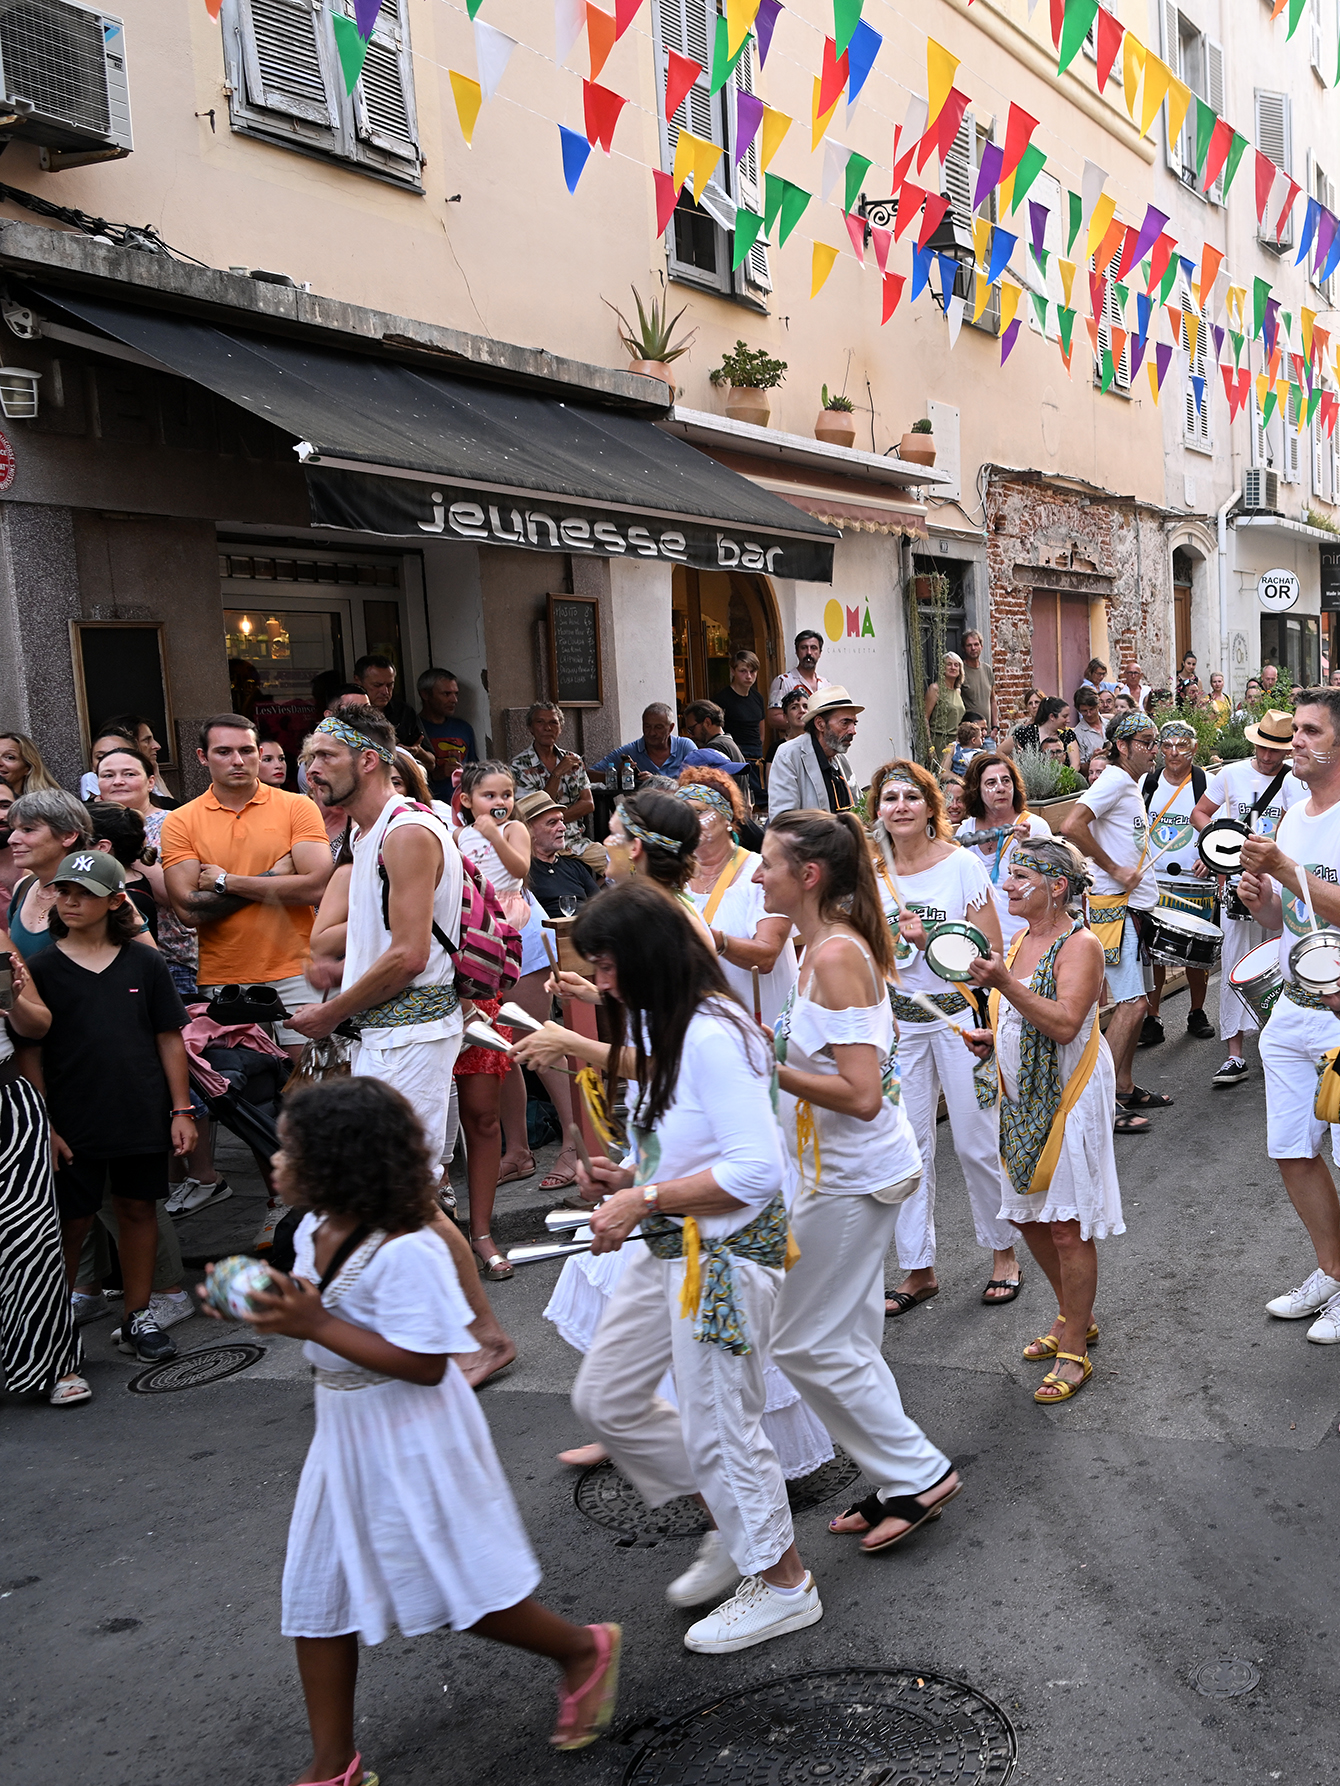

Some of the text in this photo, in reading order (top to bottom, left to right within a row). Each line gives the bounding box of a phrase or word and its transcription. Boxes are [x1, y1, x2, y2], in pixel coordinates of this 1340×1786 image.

[416, 491, 784, 572] jeunesse bar
[1261, 577, 1295, 585] RACHAT
[1264, 584, 1291, 599] OR
